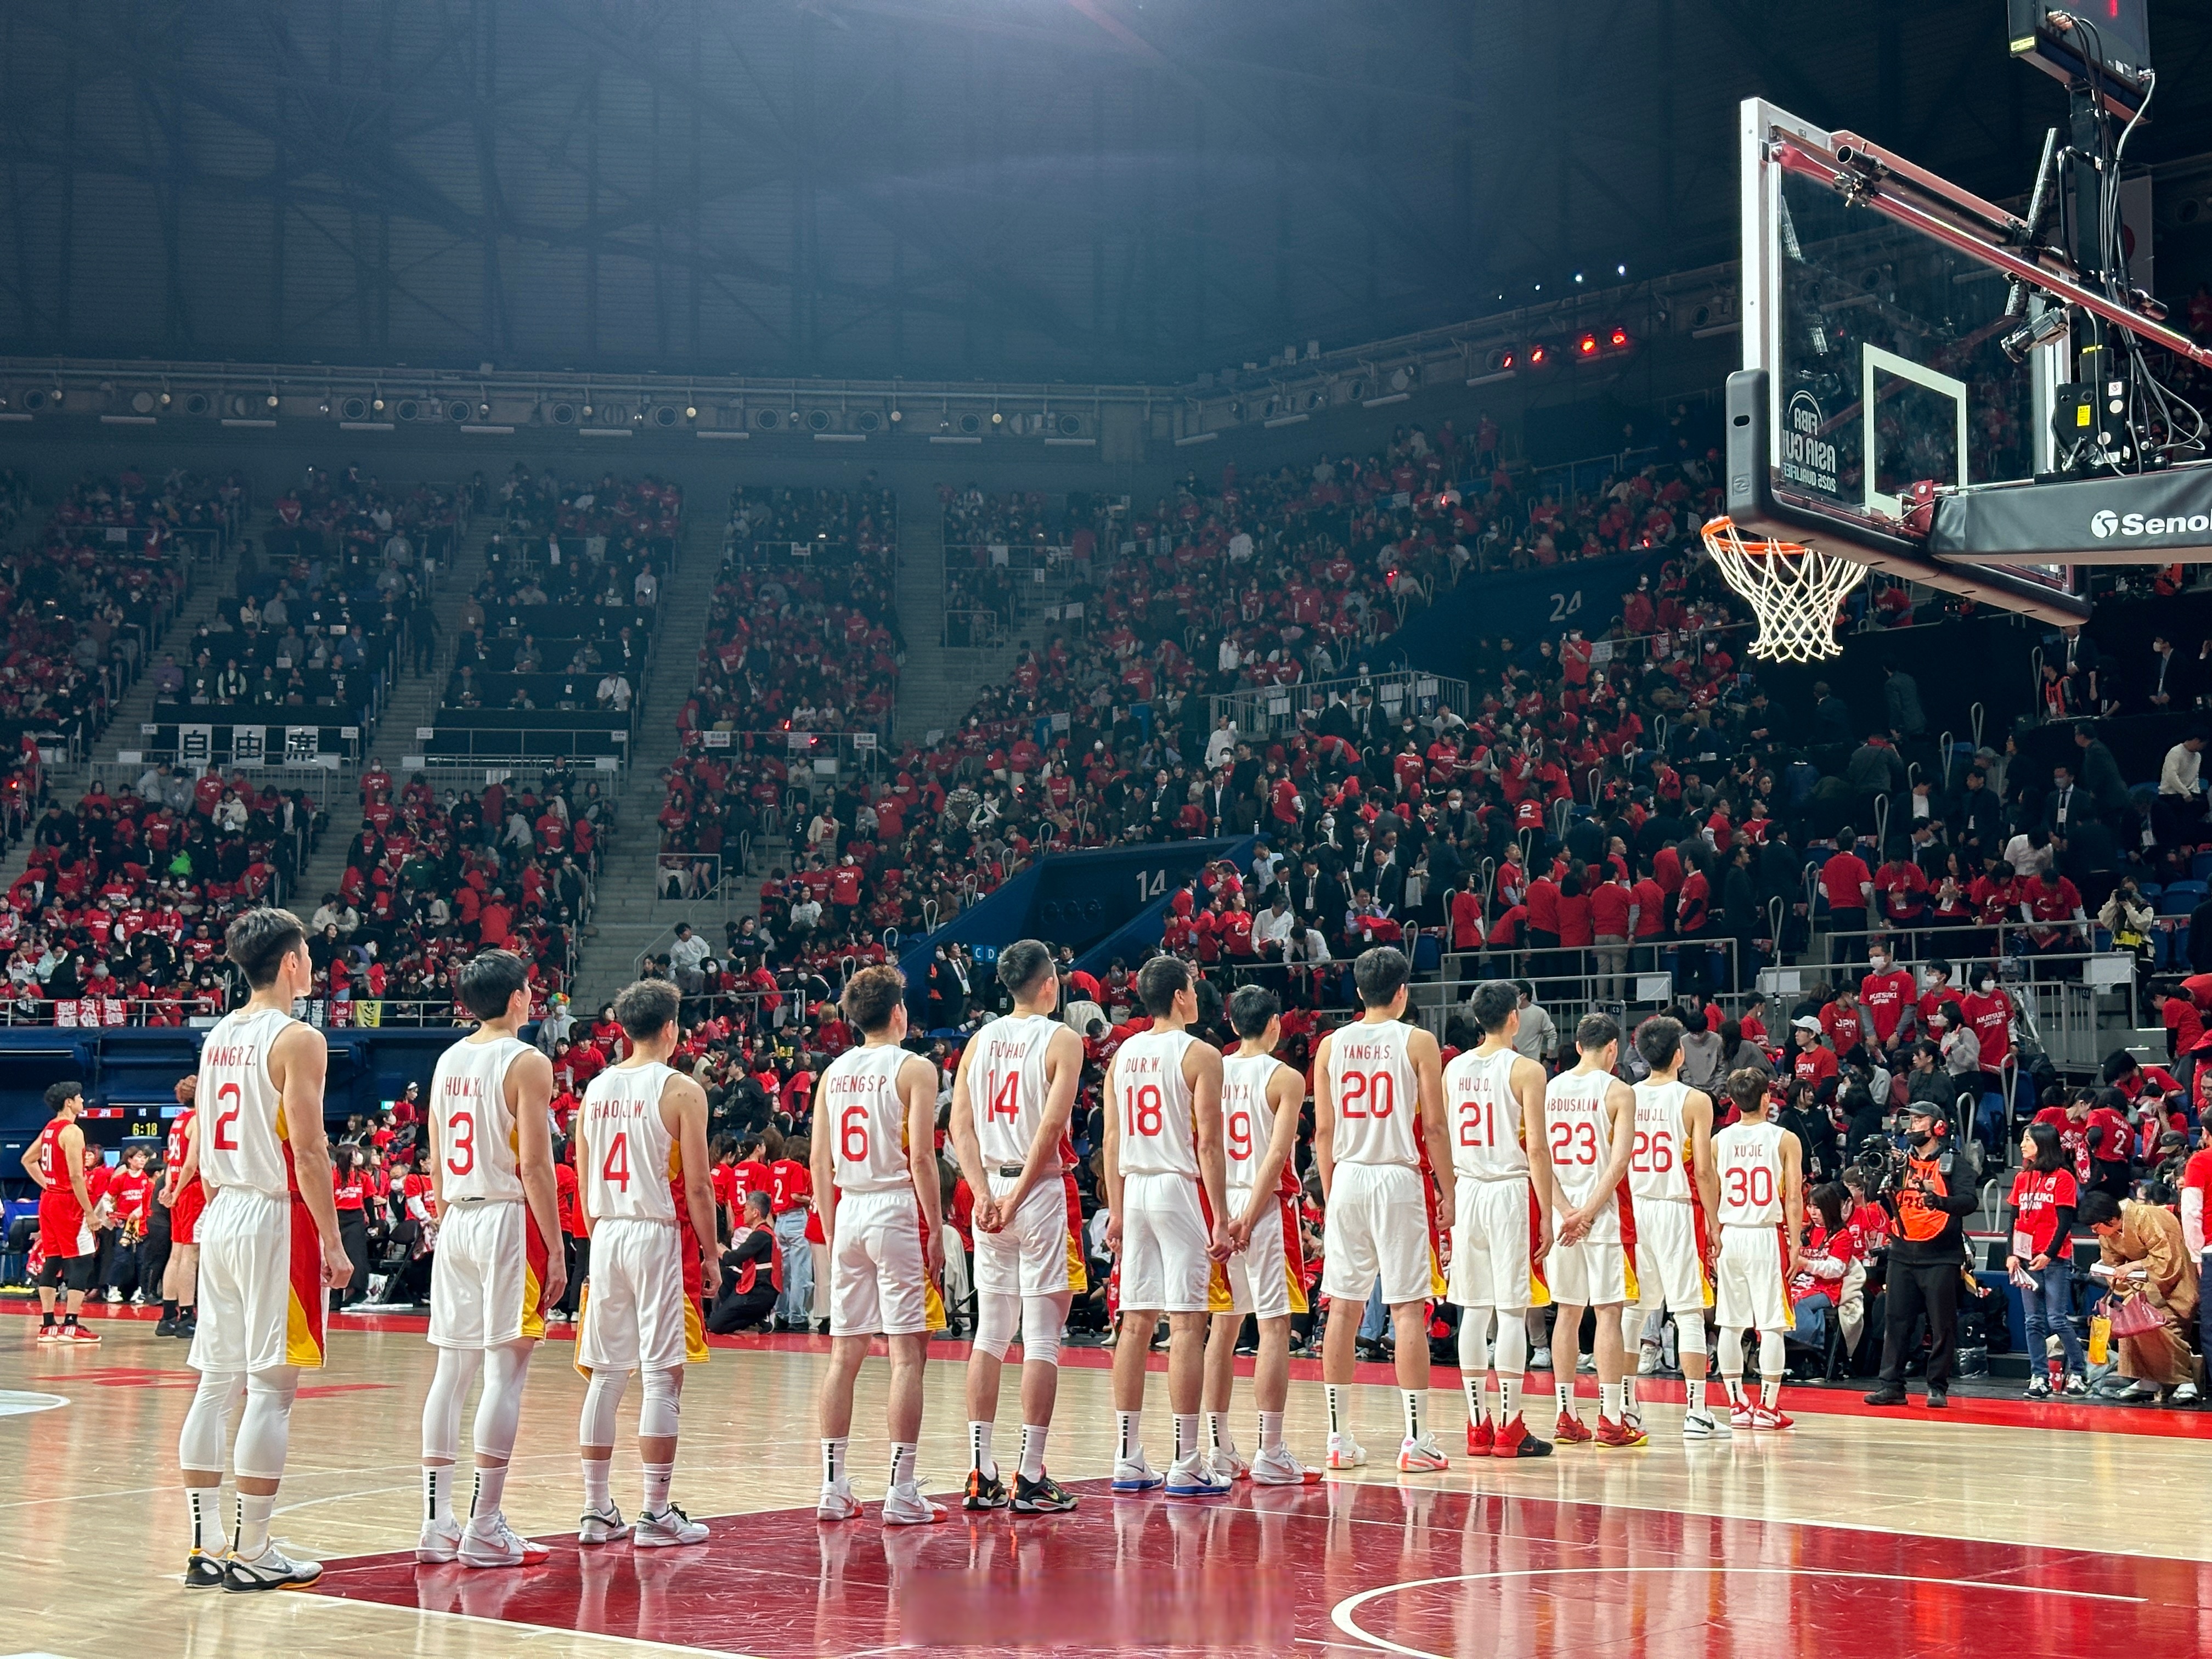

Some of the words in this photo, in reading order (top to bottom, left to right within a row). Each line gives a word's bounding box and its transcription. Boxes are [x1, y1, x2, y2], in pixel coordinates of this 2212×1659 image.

[1550, 590, 1582, 622] 24
[183, 730, 317, 761] 自由席
[1520, 804, 1532, 817] 2
[795, 822, 802, 832] 5
[1136, 868, 1167, 902] 14
[975, 948, 981, 958] C
[988, 949, 995, 959] D
[1835, 1019, 1856, 1028] JPN
[1977, 1011, 2006, 1024] AKATSUKI
[1984, 1018, 2002, 1029] JAPAN
[990, 1040, 1005, 1058] FU
[1006, 1042, 1026, 1059] HAO
[1099, 1039, 1118, 1057] JPN
[1344, 1045, 1371, 1059] YANG
[1374, 1045, 1393, 1059] H.S.
[1125, 1057, 1138, 1073] DU
[1140, 1057, 1161, 1073] R.W.
[1796, 1063, 1815, 1073] JPN
[445, 1076, 461, 1096] HU
[830, 1075, 866, 1094] CHENG
[867, 1075, 889, 1094] S.P.
[1341, 1071, 1393, 1119] 20
[1459, 1077, 1471, 1092] HU
[988, 1069, 1019, 1125] 14
[1547, 1098, 1599, 1112] ABDUSALAM
[215, 1083, 241, 1150] 2
[591, 1100, 619, 1121] ZHAO
[623, 1099, 647, 1120] J.W.
[1126, 1084, 1163, 1136] 18
[1634, 1108, 1650, 1122] HU
[1652, 1108, 1668, 1122] J.L.
[132, 1122, 158, 1136] 6:18
[842, 1105, 869, 1162] 6
[1459, 1102, 1494, 1147] 21
[168, 1133, 180, 1160] 99
[447, 1111, 474, 1176] 3
[1550, 1122, 1597, 1165] 23
[1631, 1131, 1672, 1173] 26
[1734, 1144, 1746, 1158] XU
[1748, 1144, 1763, 1158] JIE
[2113, 1130, 2126, 1155] 2
[41, 1143, 52, 1172] 91
[603, 1132, 630, 1193] 4
[736, 1181, 747, 1205] 5
[774, 1180, 783, 1204] 2
[1725, 1166, 1773, 1207] 30
